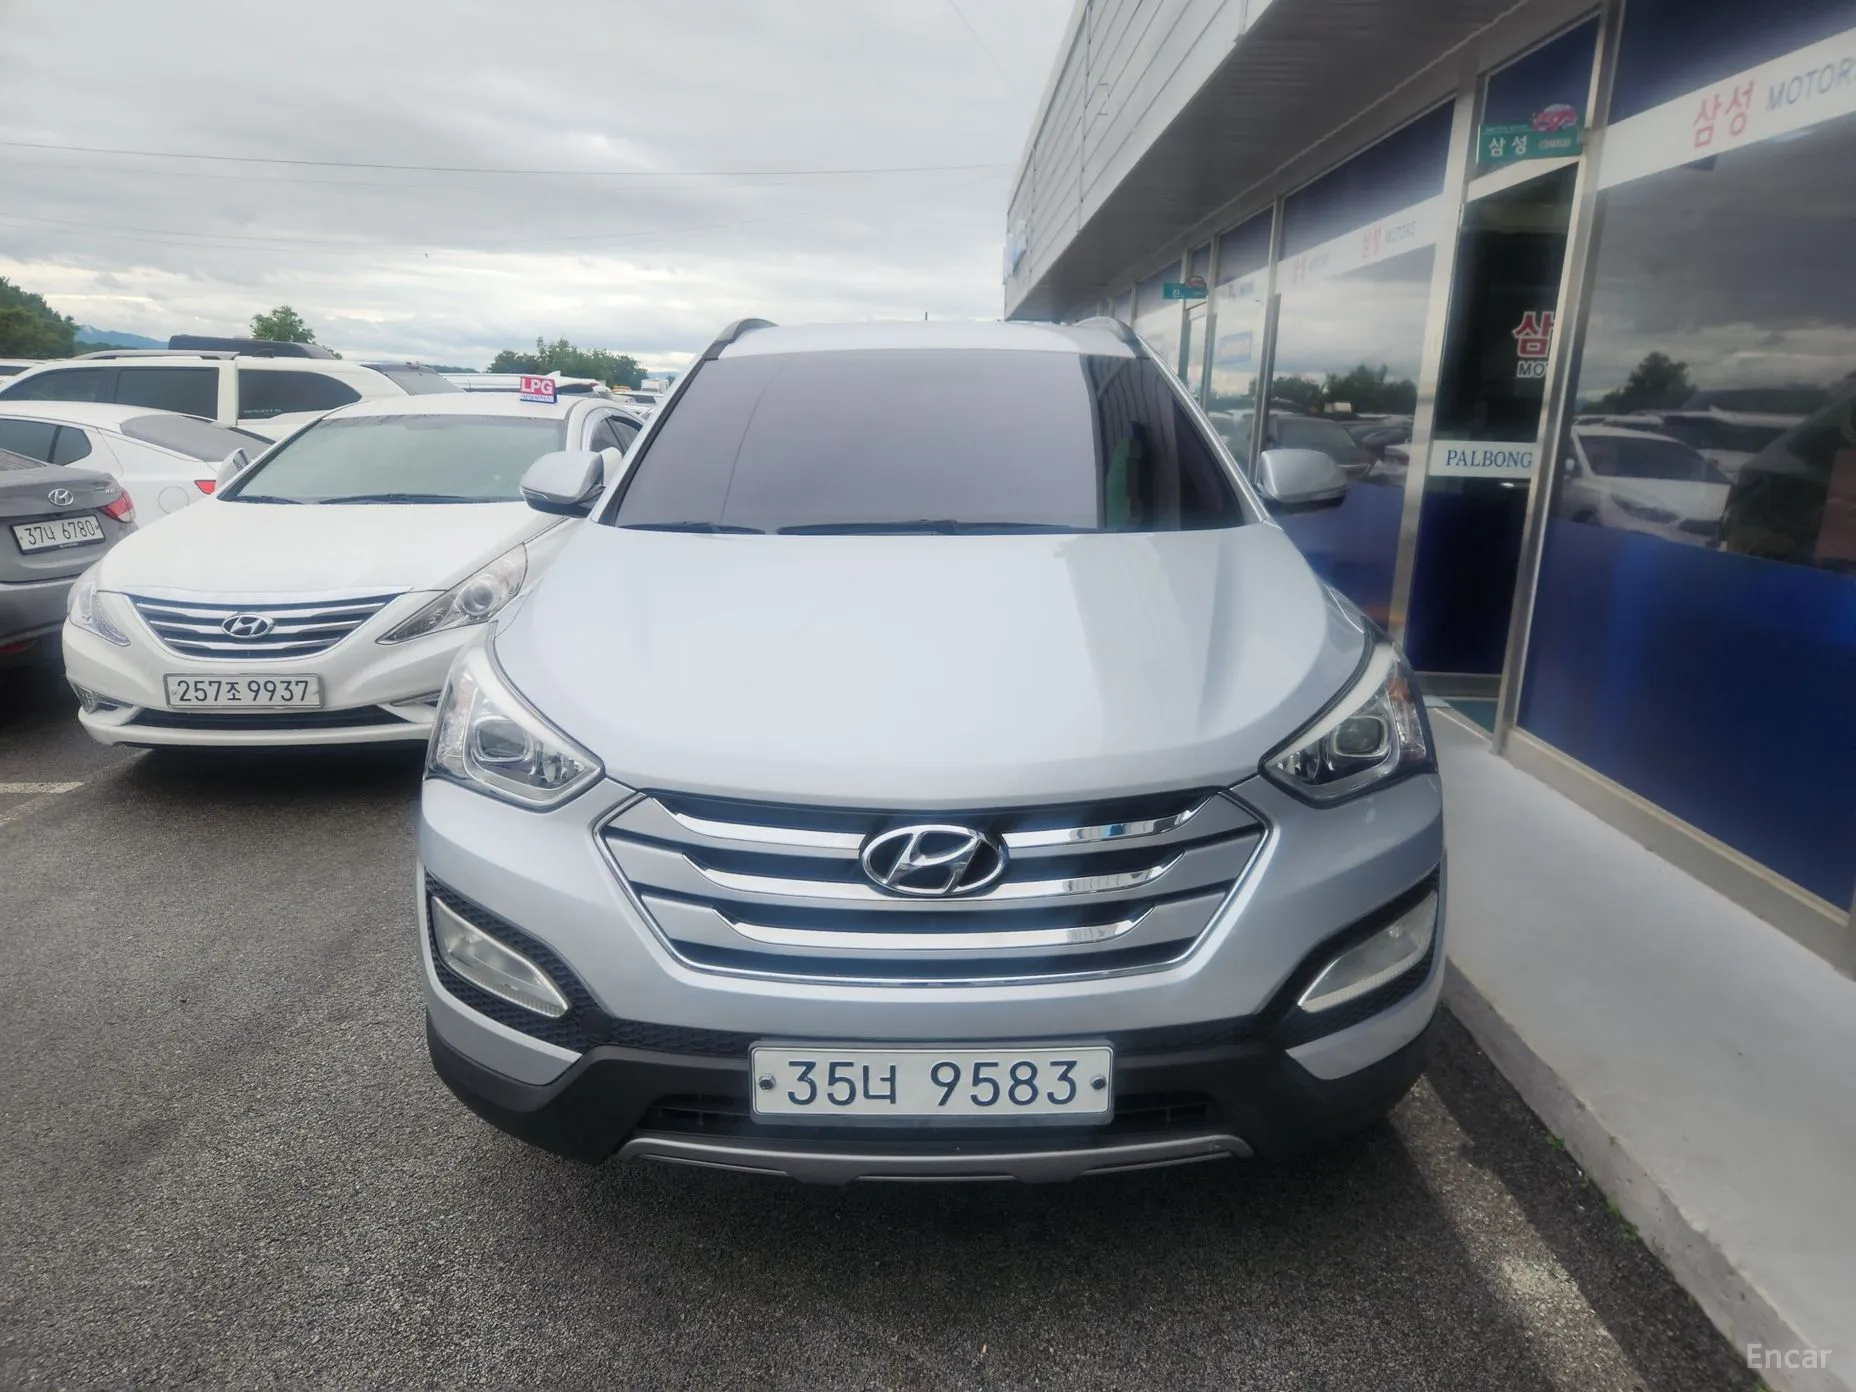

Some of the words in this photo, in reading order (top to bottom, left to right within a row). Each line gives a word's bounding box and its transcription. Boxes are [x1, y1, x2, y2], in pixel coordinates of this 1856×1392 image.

[1692, 78, 1754, 149] 삼성
[1766, 56, 1856, 112] MOTOR
[1516, 360, 1548, 378] MO
[521, 378, 554, 395] LPG
[1445, 449, 1533, 468] PALBONG
[62, 519, 95, 540] 6780
[177, 680, 242, 702] 257조
[247, 680, 309, 702] 9937
[787, 1060, 897, 1106] 35너
[929, 1060, 1078, 1107] 9583
